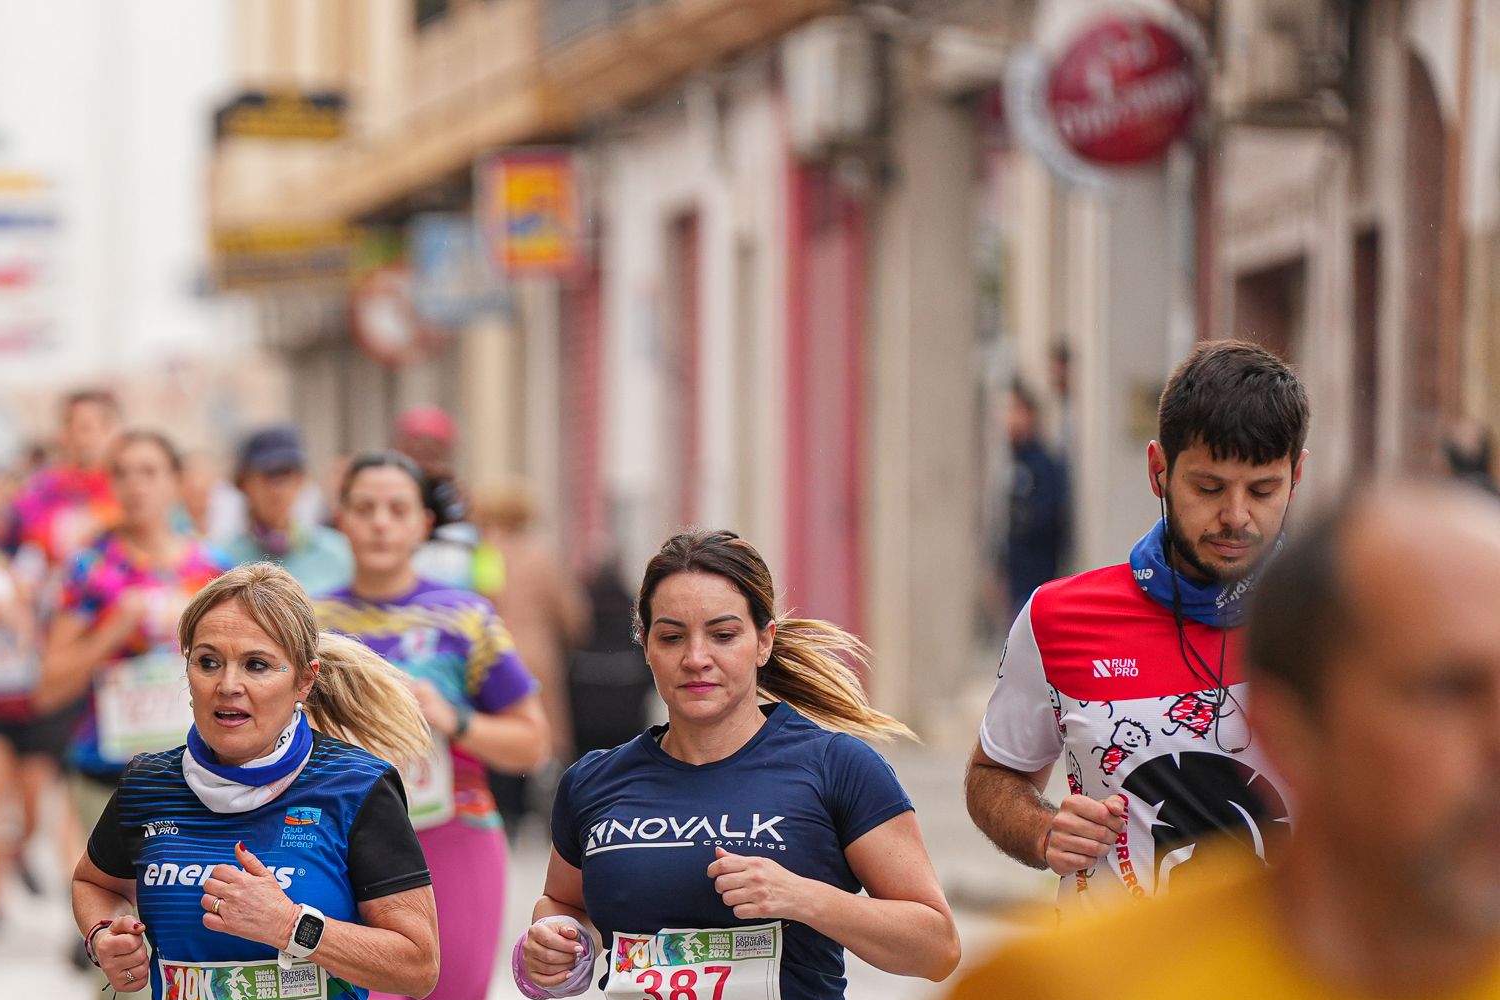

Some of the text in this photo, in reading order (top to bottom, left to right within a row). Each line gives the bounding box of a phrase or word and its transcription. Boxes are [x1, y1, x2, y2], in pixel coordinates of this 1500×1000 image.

[1111, 658, 1136, 668] RUN
[1114, 667, 1139, 677] PRO
[158, 826, 179, 835] PRO
[283, 826, 303, 834] Club
[281, 832, 318, 842] Maratón
[280, 840, 313, 849] Lucena
[703, 840, 787, 851] COATINGS
[735, 934, 766, 942] carreras
[735, 939, 772, 948] populares
[708, 949, 730, 958] 2026
[280, 969, 310, 978] carreras
[281, 973, 317, 985] populares
[256, 988, 278, 1000] 2026
